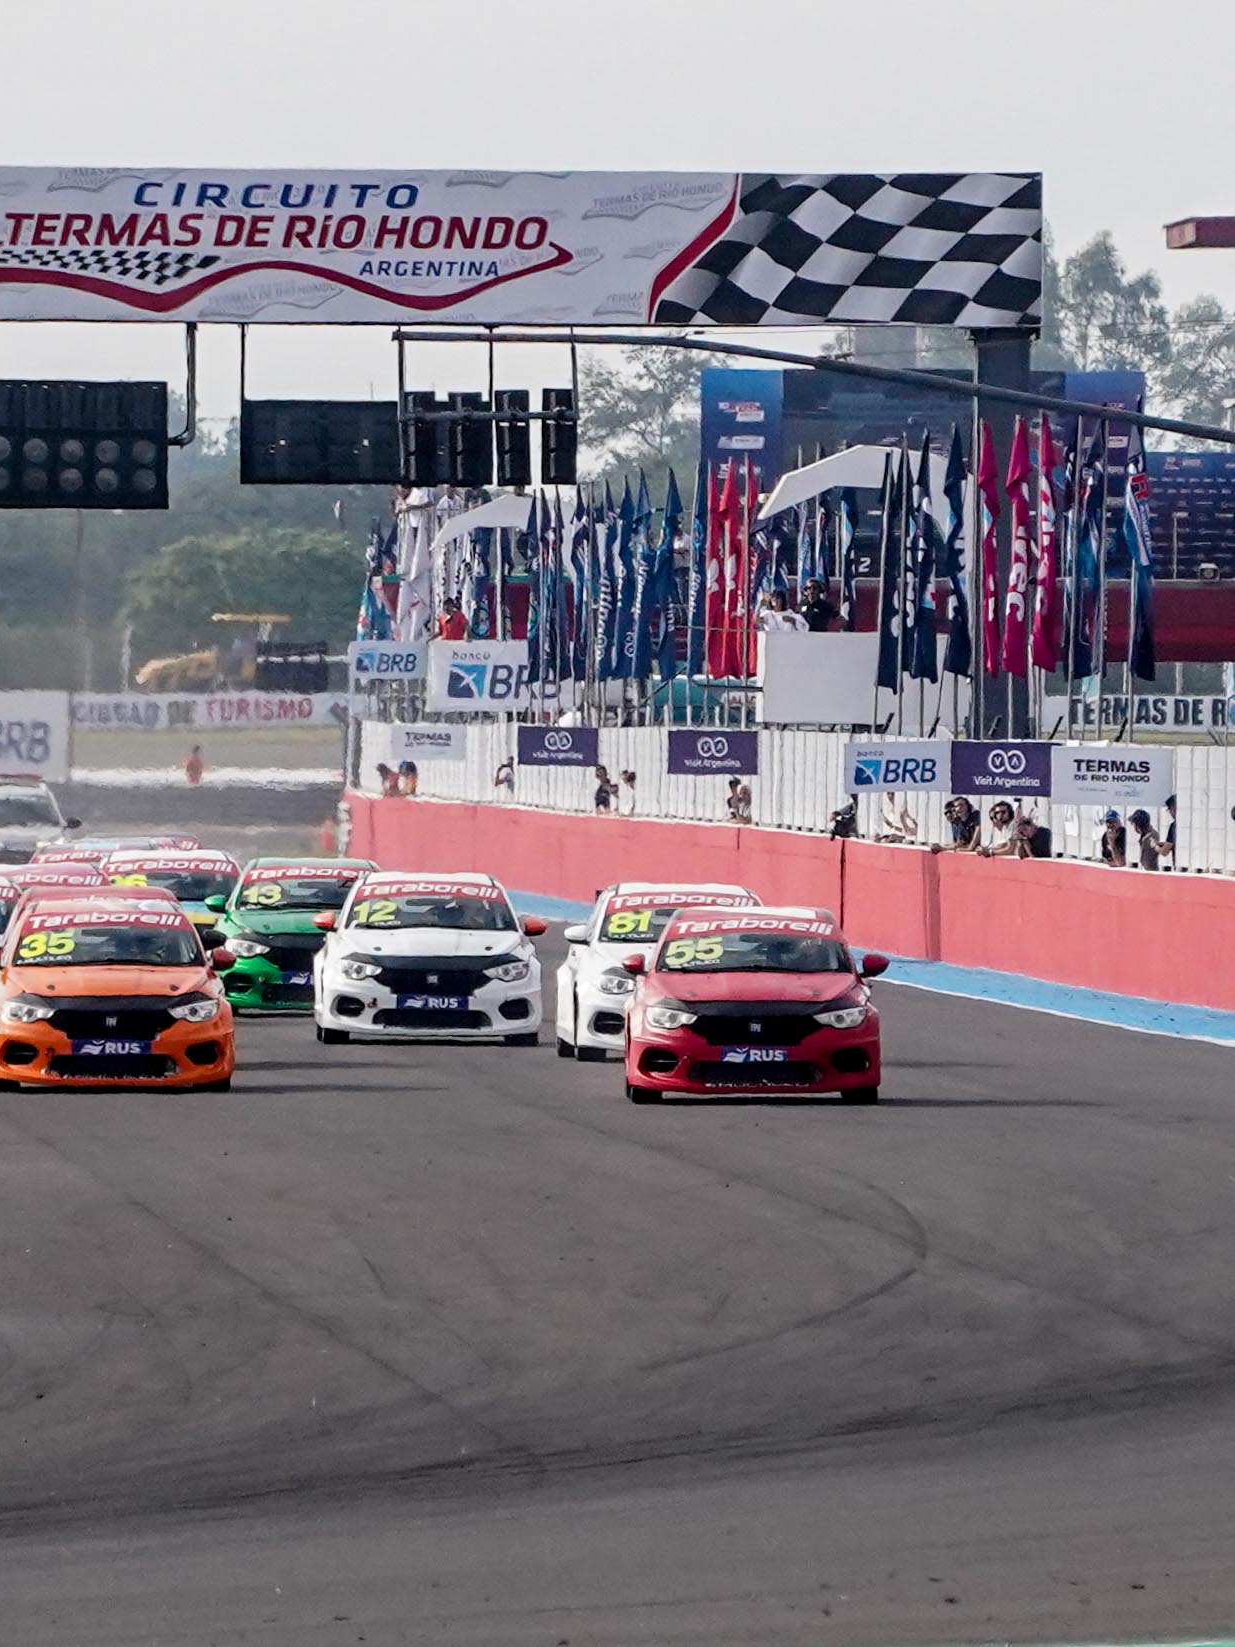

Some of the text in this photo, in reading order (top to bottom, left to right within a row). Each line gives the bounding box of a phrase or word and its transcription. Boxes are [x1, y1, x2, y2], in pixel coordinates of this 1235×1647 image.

[134, 182, 419, 209] CIRCUITO
[4, 212, 203, 248] TERMAS
[214, 213, 277, 248] DE
[376, 216, 549, 250] HONDO
[358, 260, 500, 277] ARGENTINA
[375, 652, 418, 674] BRB
[452, 650, 492, 661] banco
[206, 698, 313, 721] TURISMO
[1174, 698, 1204, 725] DE
[883, 758, 937, 784] BRB
[1073, 758, 1150, 773] TERMAS
[974, 775, 1041, 788] Visit Argentina
[1074, 774, 1088, 782] DE
[1112, 775, 1150, 783] HONDO
[107, 859, 233, 873] Taraborelli
[243, 883, 282, 905] 13
[363, 882, 500, 899] Taraborelli
[611, 893, 755, 909] Taraborelli
[353, 900, 398, 923] 12
[29, 912, 183, 929] Taraborelli
[608, 909, 653, 934] 81
[675, 917, 834, 935] Taraborelli
[19, 931, 76, 958] 35
[665, 936, 724, 966] 55
[428, 997, 459, 1009] RUS
[104, 1040, 141, 1055] RUS
[749, 1049, 785, 1062] RUS
